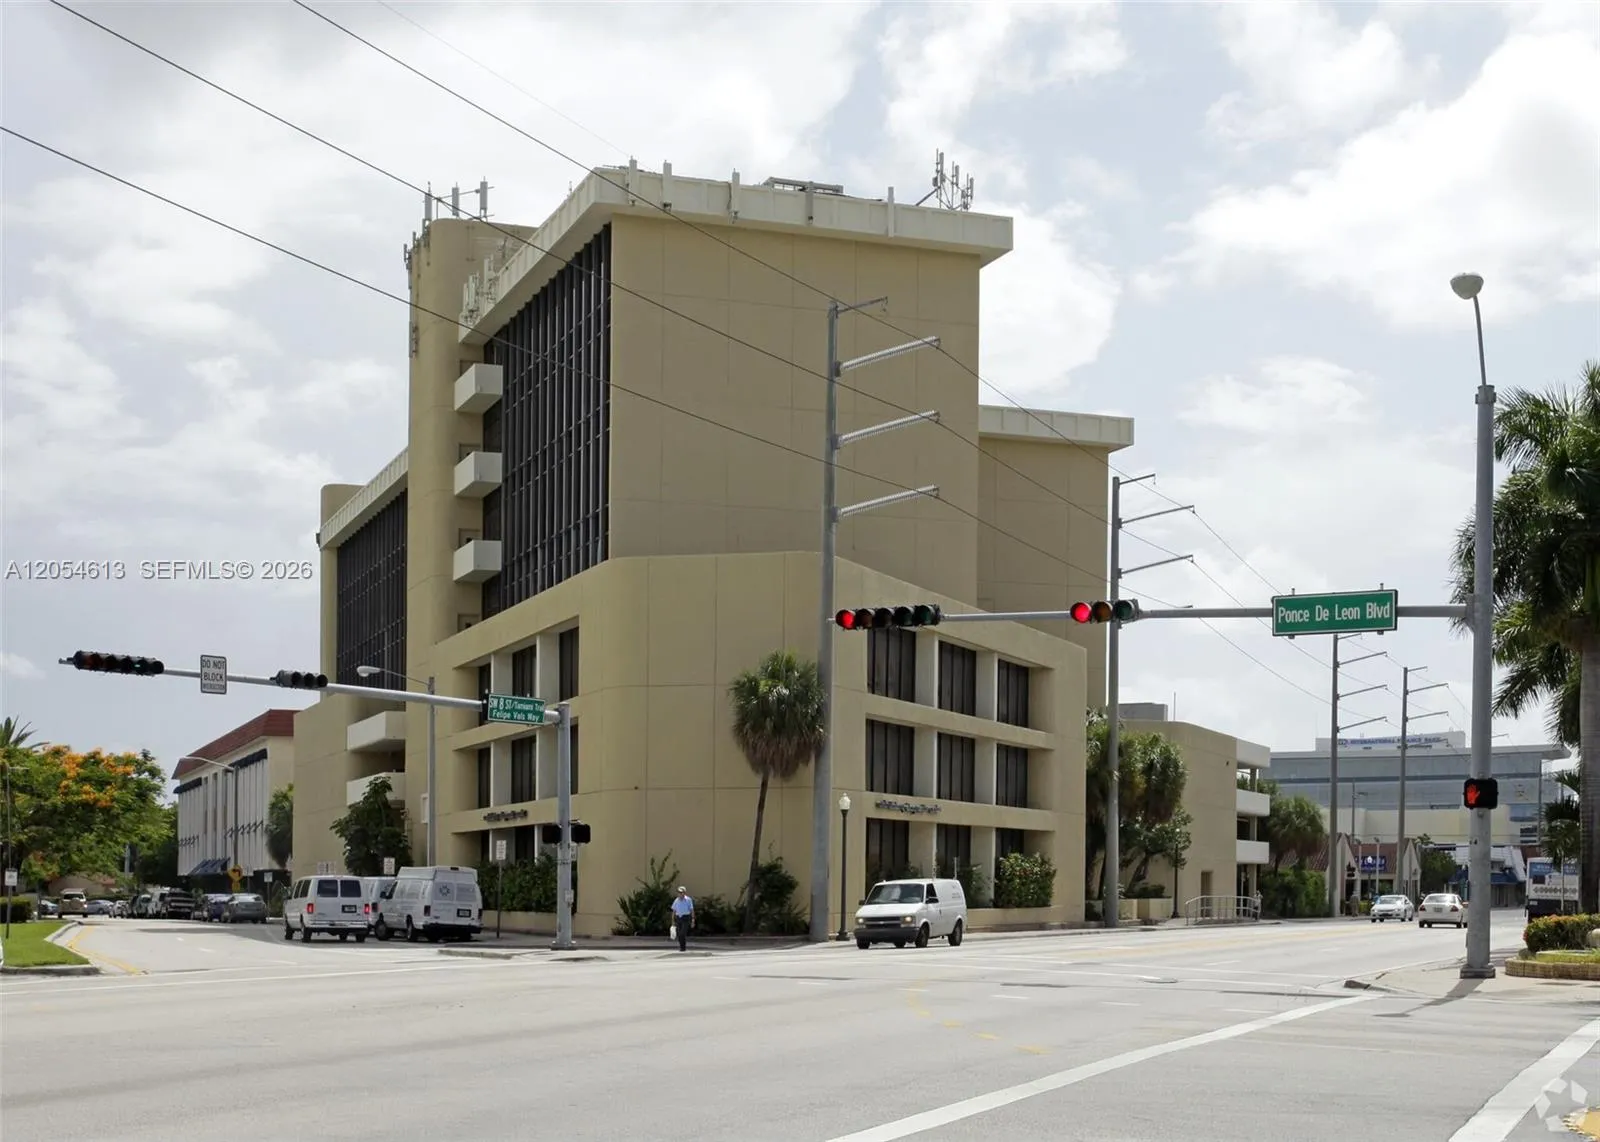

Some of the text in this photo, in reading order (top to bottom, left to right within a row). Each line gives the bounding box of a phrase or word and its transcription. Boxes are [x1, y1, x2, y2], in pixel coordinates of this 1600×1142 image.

[1278, 602, 1390, 623] Ponce De Leon Blvd
[212, 660, 225, 669] NOT
[204, 672, 224, 681] BLOCK
[499, 698, 504, 710] 8
[527, 713, 540, 722] Way
